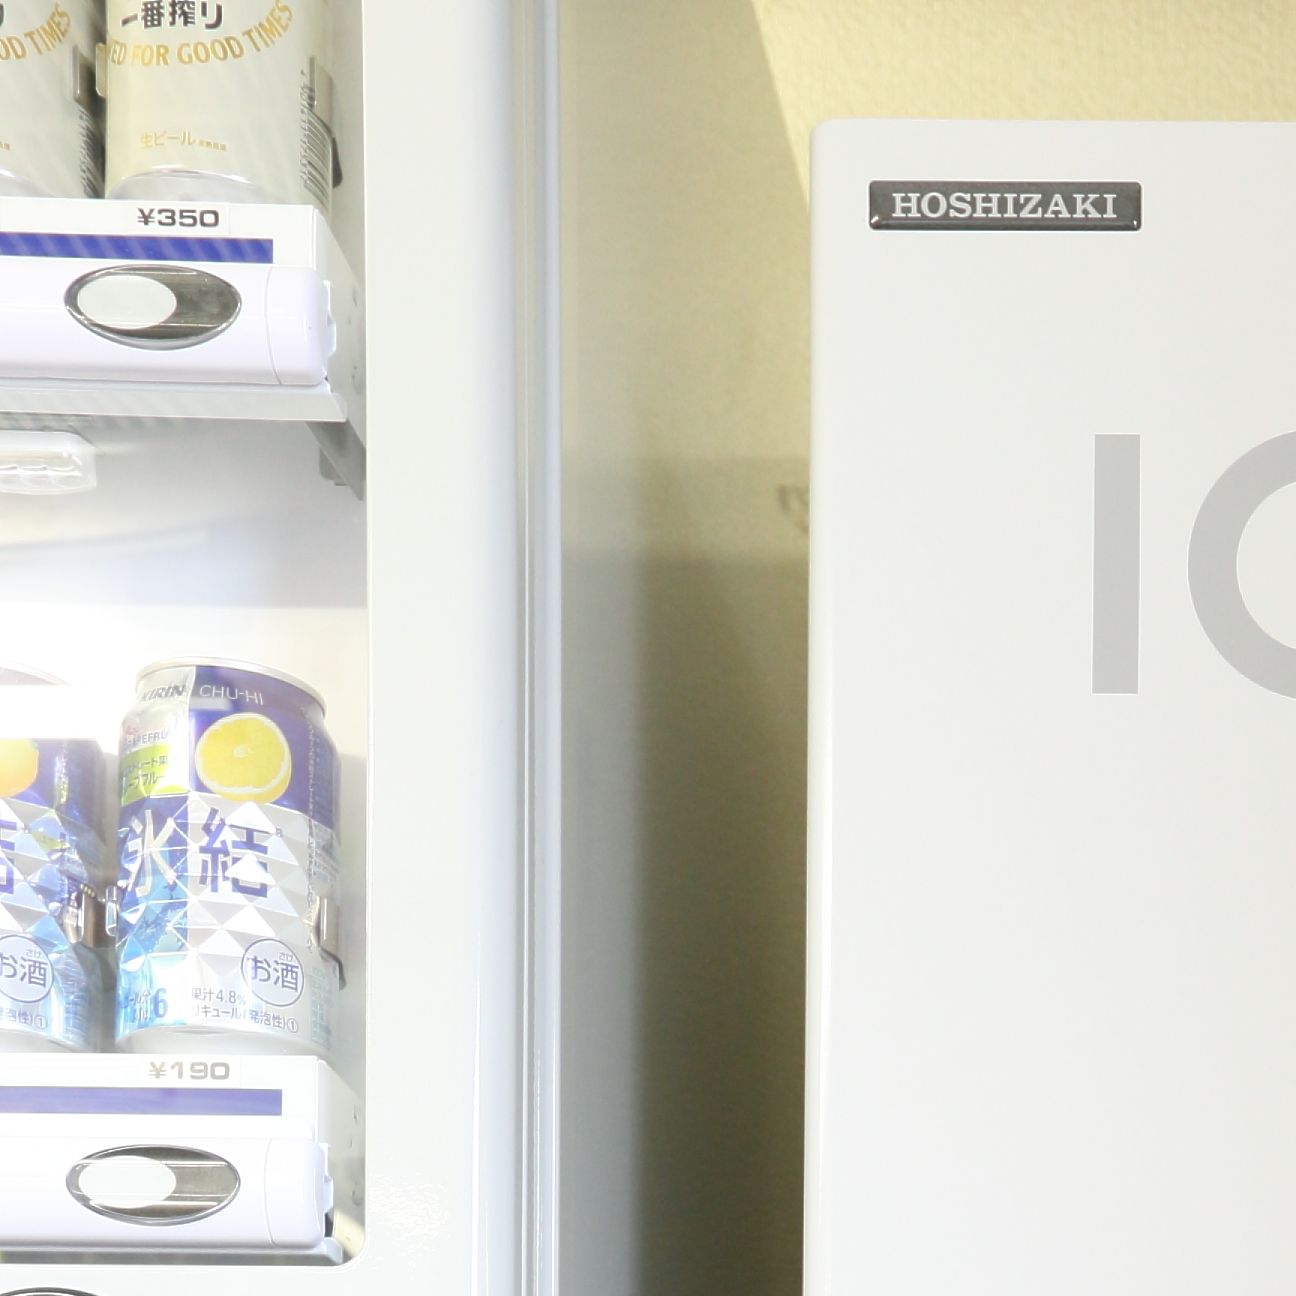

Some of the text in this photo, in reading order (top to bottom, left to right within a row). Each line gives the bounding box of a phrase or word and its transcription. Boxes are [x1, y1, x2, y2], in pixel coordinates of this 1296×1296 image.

[24, 3, 71, 54] TIMES
[131, 44, 169, 67] FOR
[176, 36, 244, 65] GOOD
[243, 0, 293, 53] TIMES
[137, 208, 220, 228] ¥350
[892, 193, 1117, 219] HOSHIZAKI
[200, 684, 264, 705] CHU-HI
[119, 808, 268, 897] 氷結
[247, 954, 299, 993] お酒
[149, 1061, 230, 1080] ¥190
